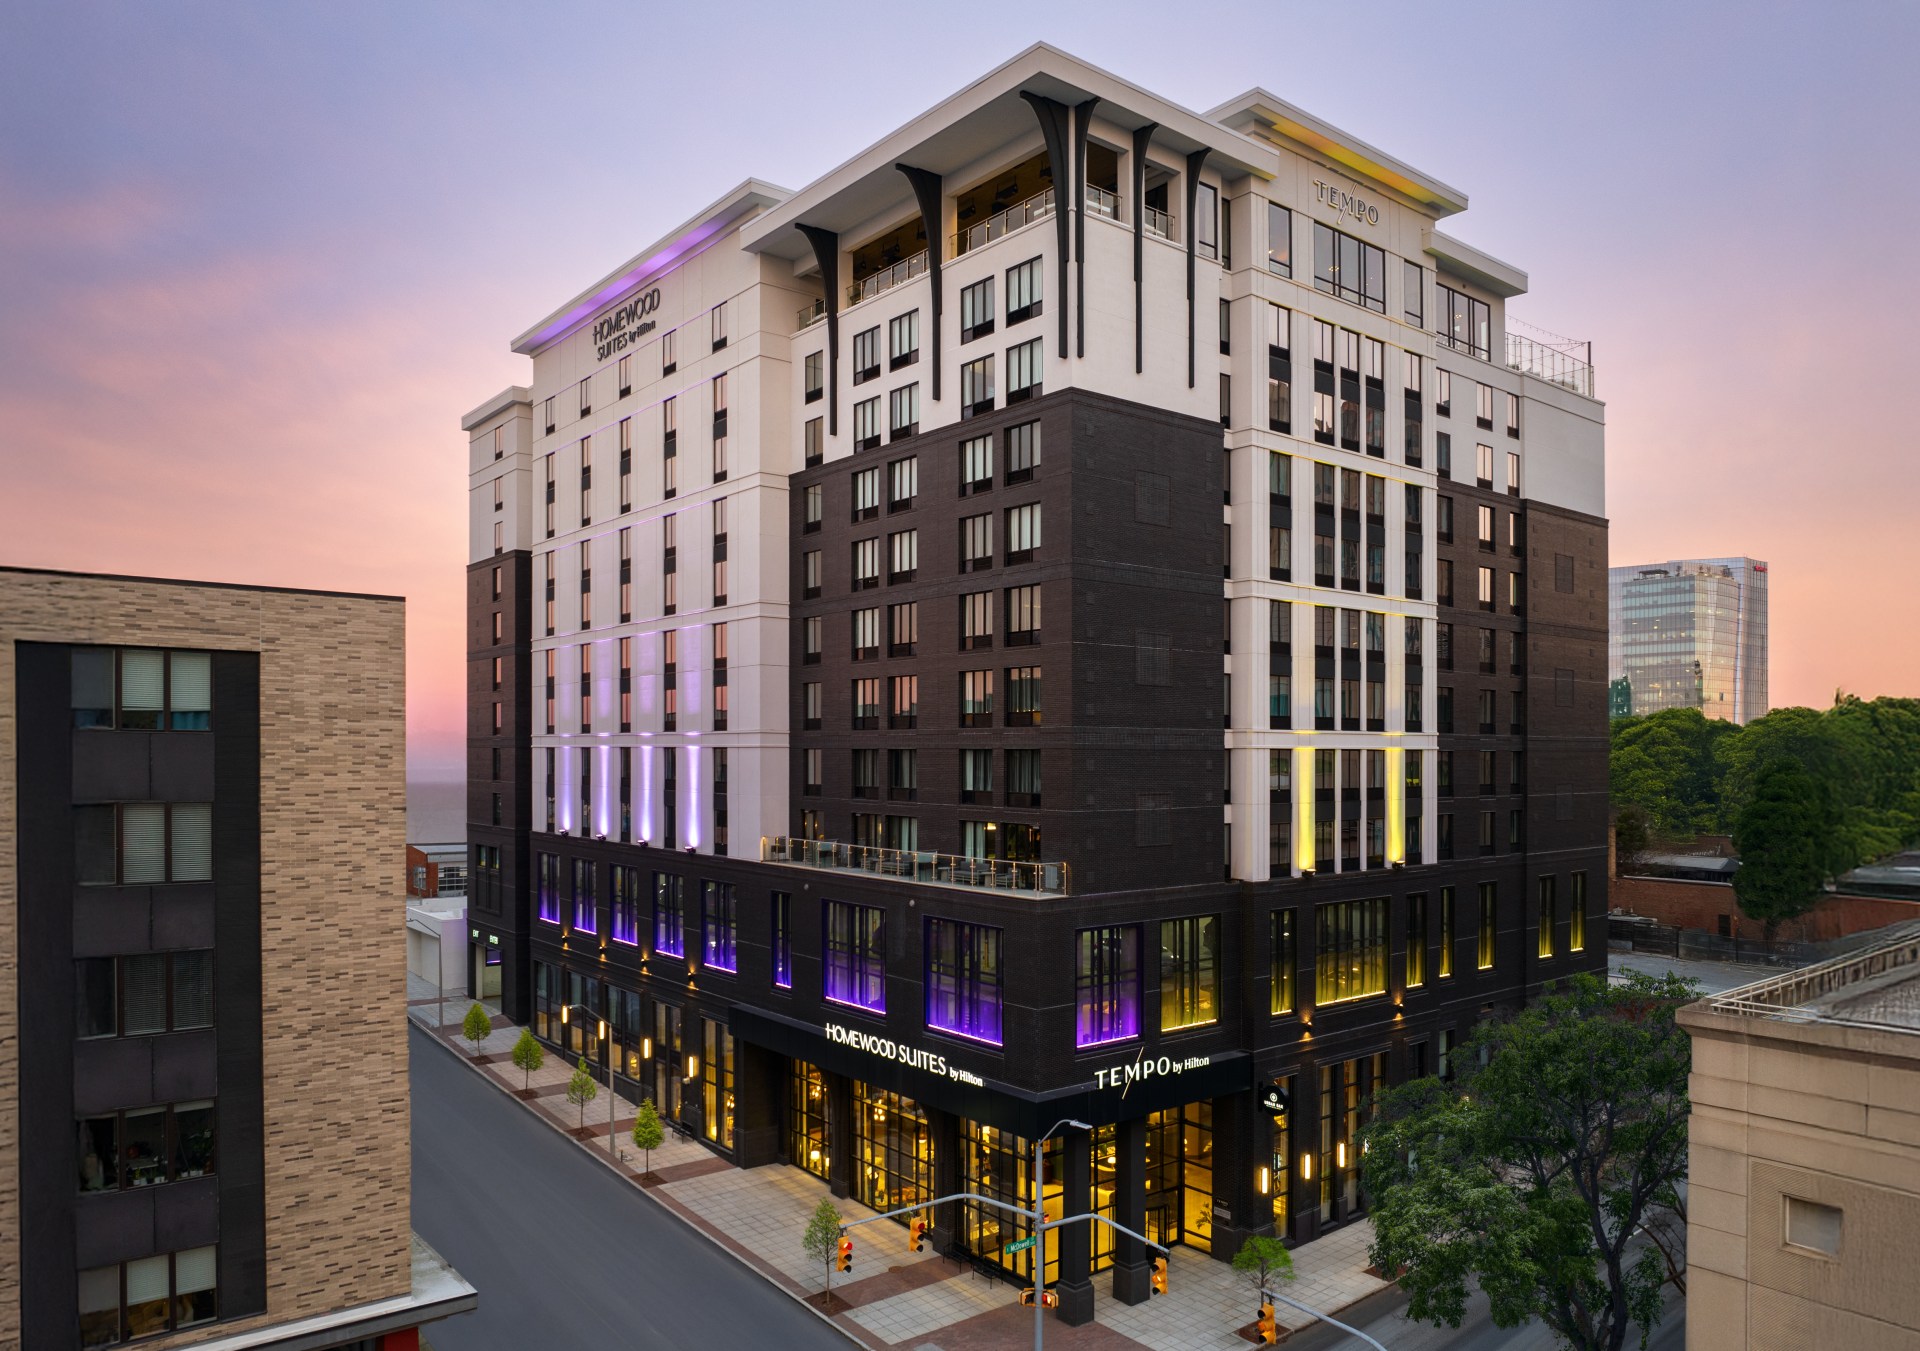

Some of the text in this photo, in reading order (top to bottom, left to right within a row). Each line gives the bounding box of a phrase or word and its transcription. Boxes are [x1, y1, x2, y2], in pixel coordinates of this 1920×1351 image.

[1313, 178, 1379, 226] TEMPO
[592, 287, 661, 346] HOMEWOOD
[597, 320, 656, 362] SUITES by Hilton
[825, 1022, 984, 1087] HOMEWOOD SUITES by Hilton
[1094, 1046, 1210, 1100] TEMPO by Hilton
